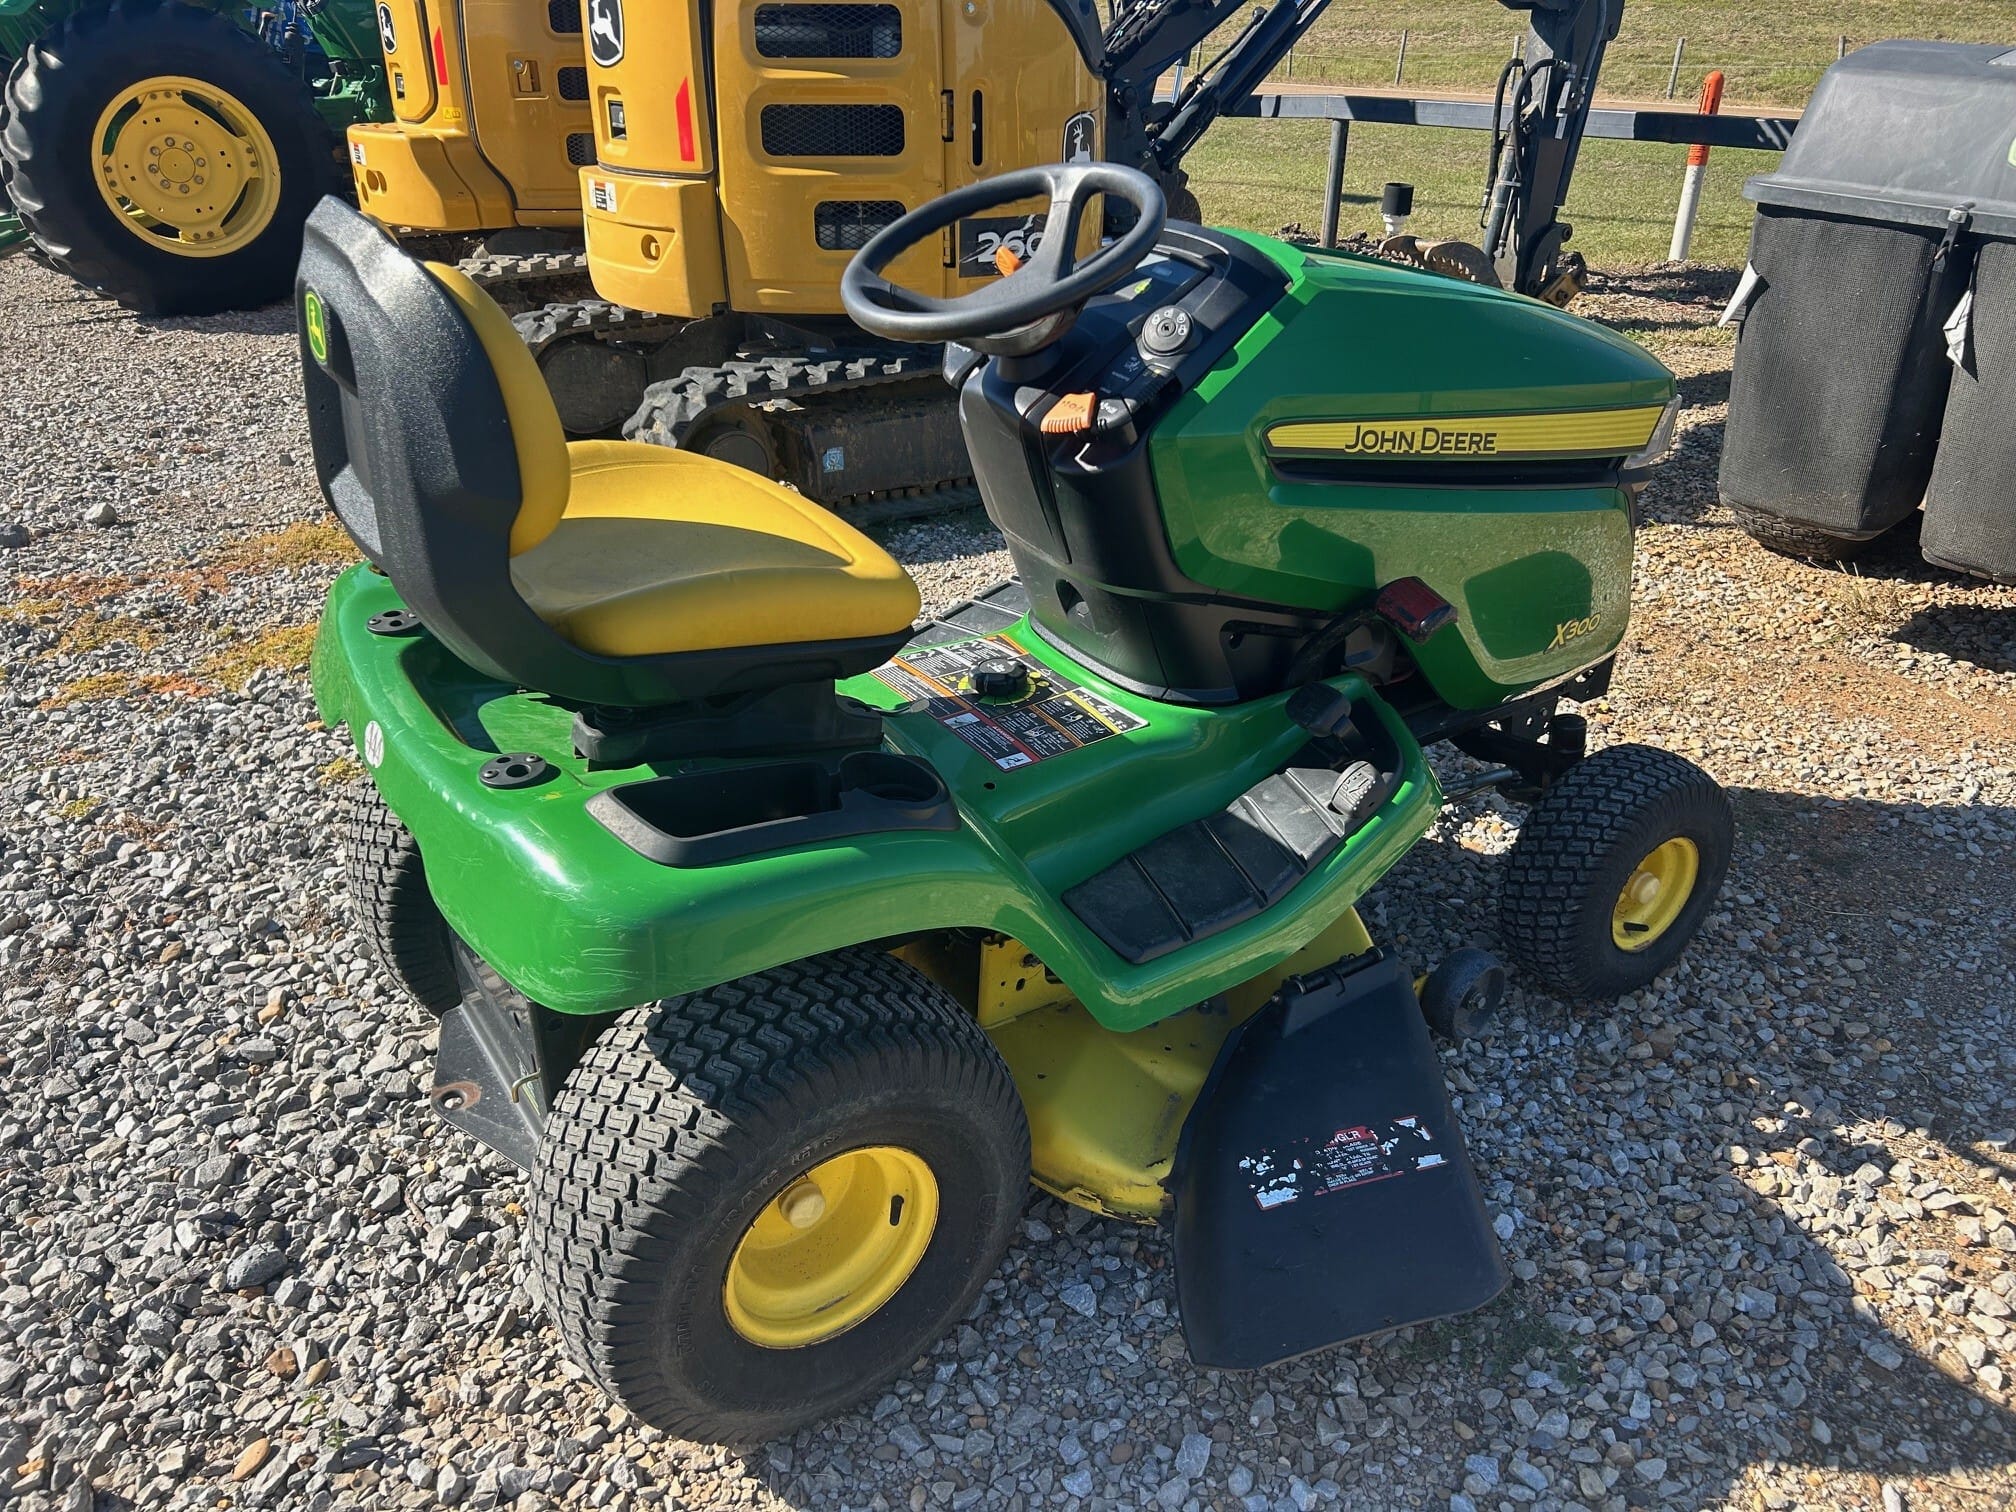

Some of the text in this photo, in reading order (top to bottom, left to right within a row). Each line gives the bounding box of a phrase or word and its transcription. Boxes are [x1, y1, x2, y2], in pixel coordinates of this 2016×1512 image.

[1344, 424, 1498, 453] JOHN DEERE
[1543, 612, 1602, 655] X300
